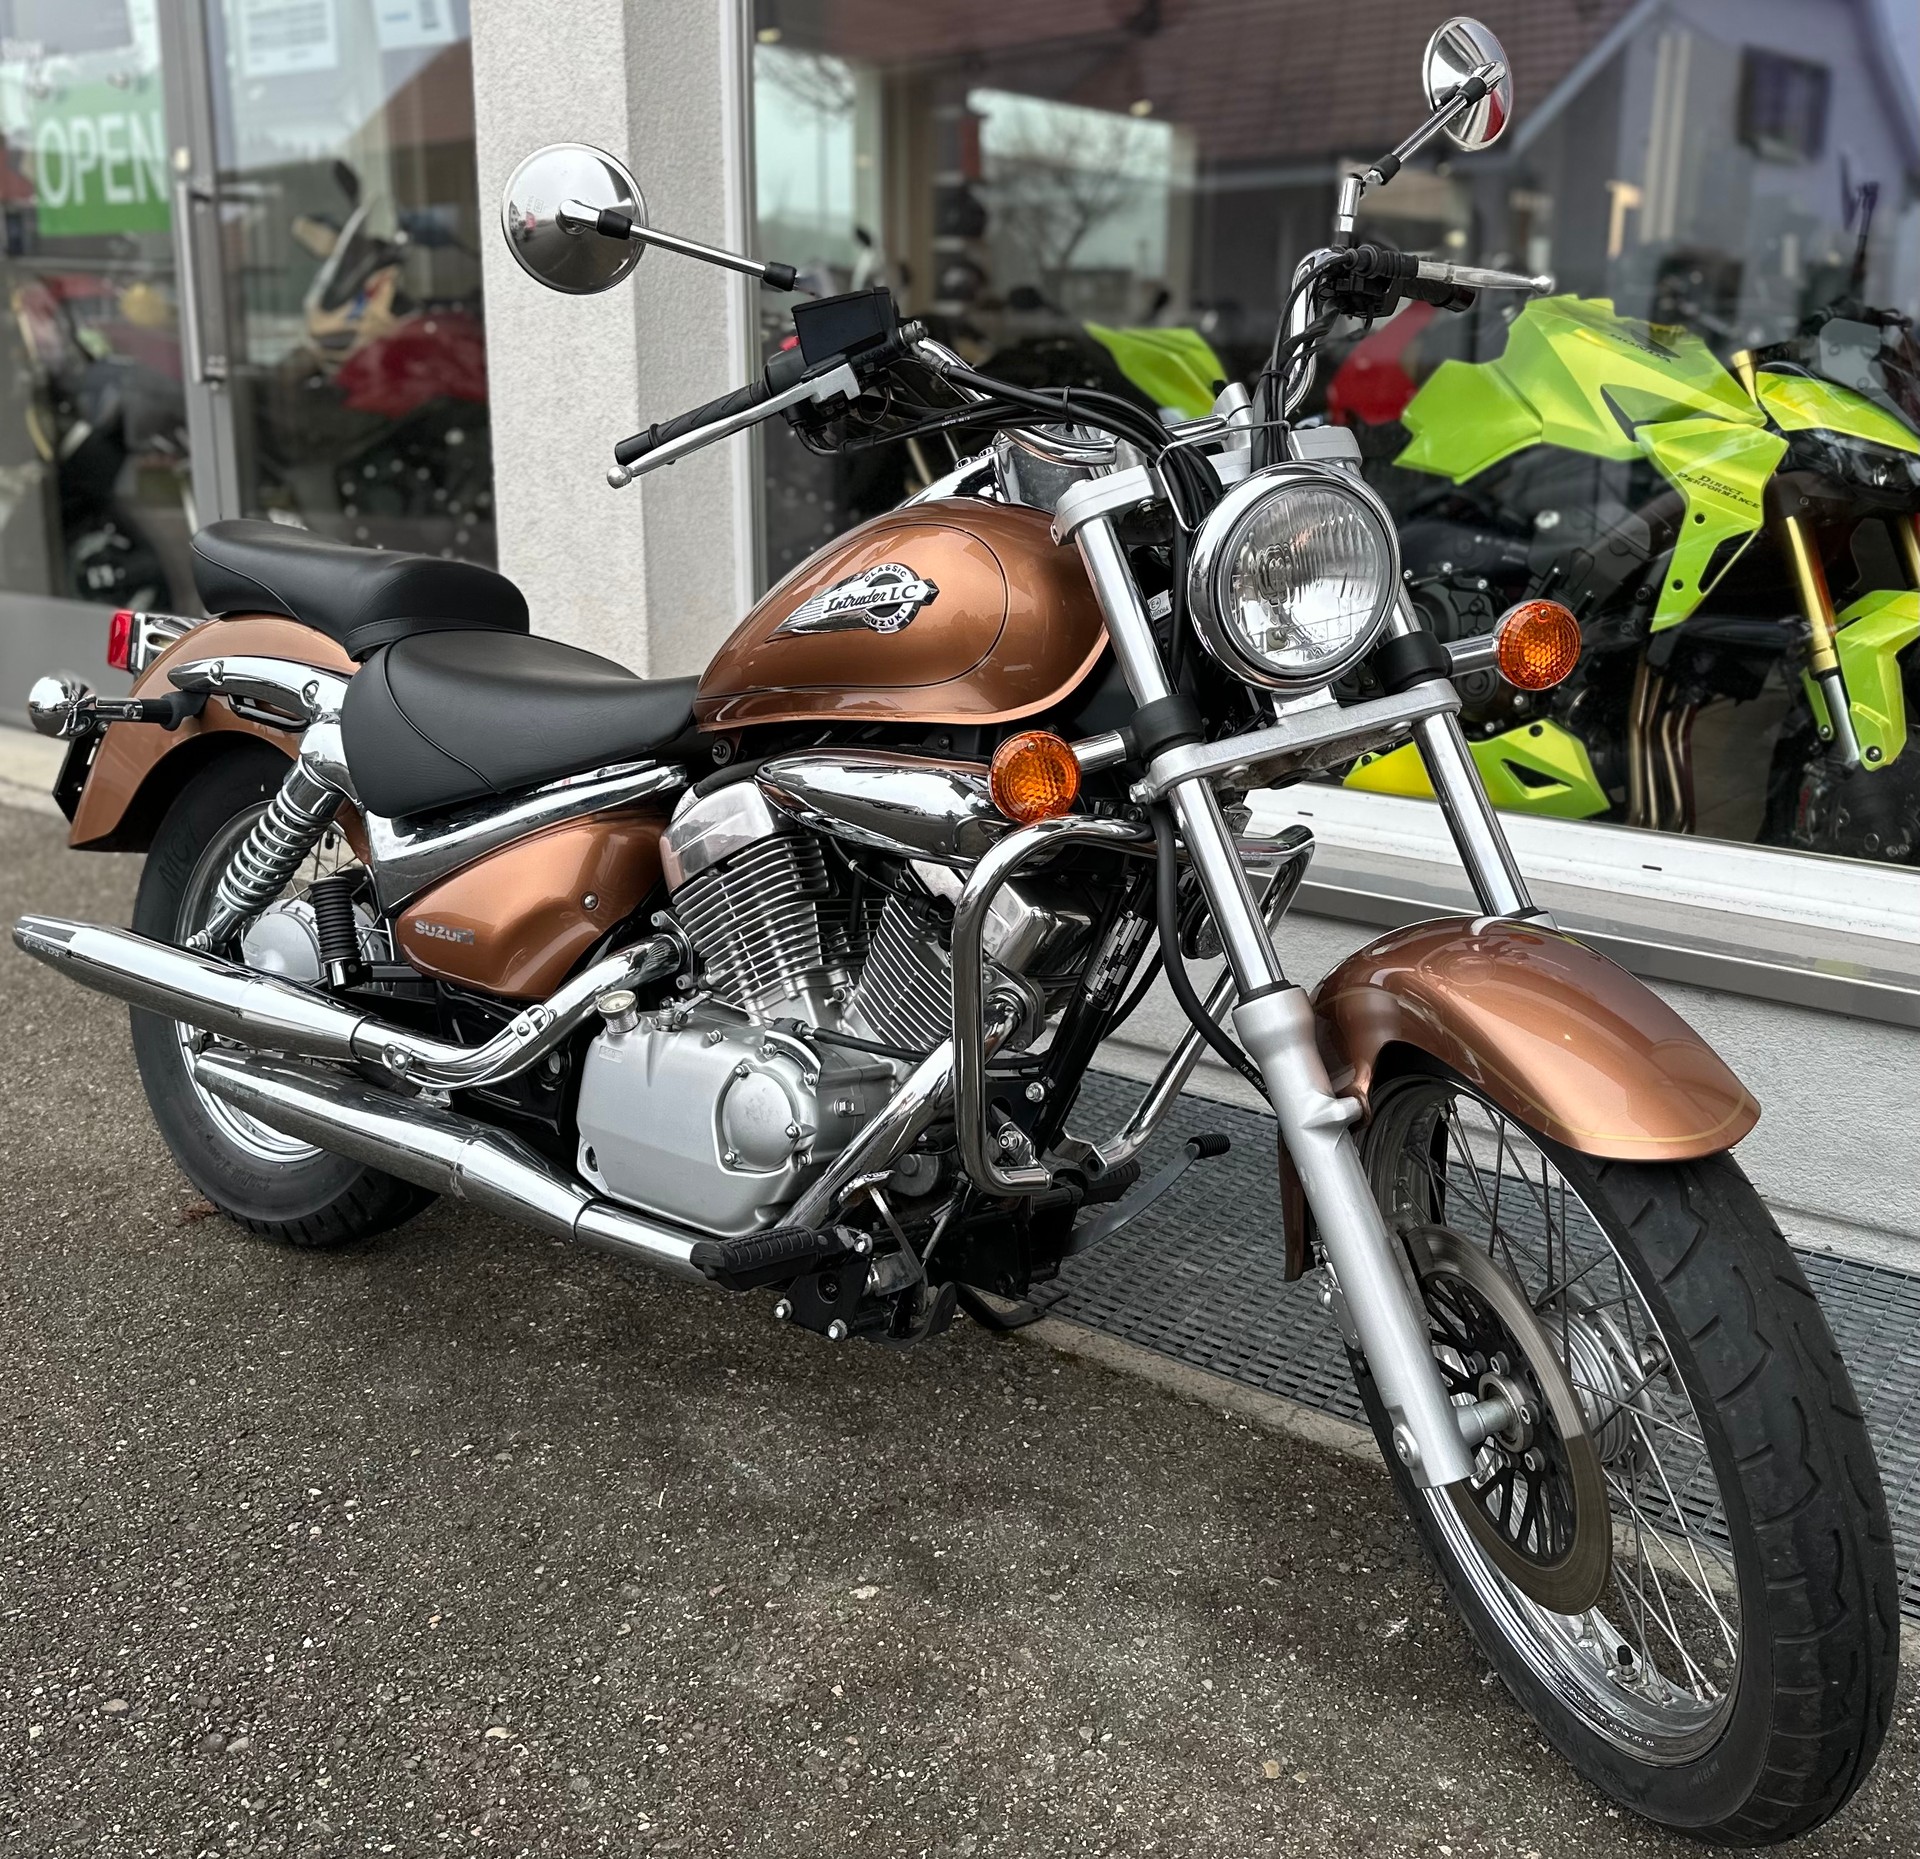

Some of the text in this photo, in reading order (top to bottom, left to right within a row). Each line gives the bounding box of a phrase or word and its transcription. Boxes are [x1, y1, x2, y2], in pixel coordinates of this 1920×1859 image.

[36, 112, 169, 208] OPEN
[1609, 332, 1673, 365] HONDA
[1676, 471, 1761, 510] PERFORMANCE
[1698, 474, 1745, 496] DIRECT
[864, 564, 907, 582] CLASSIC
[823, 584, 918, 614] Intruder LC
[864, 609, 906, 627] SUZUKI
[414, 919, 475, 946] SUZU
